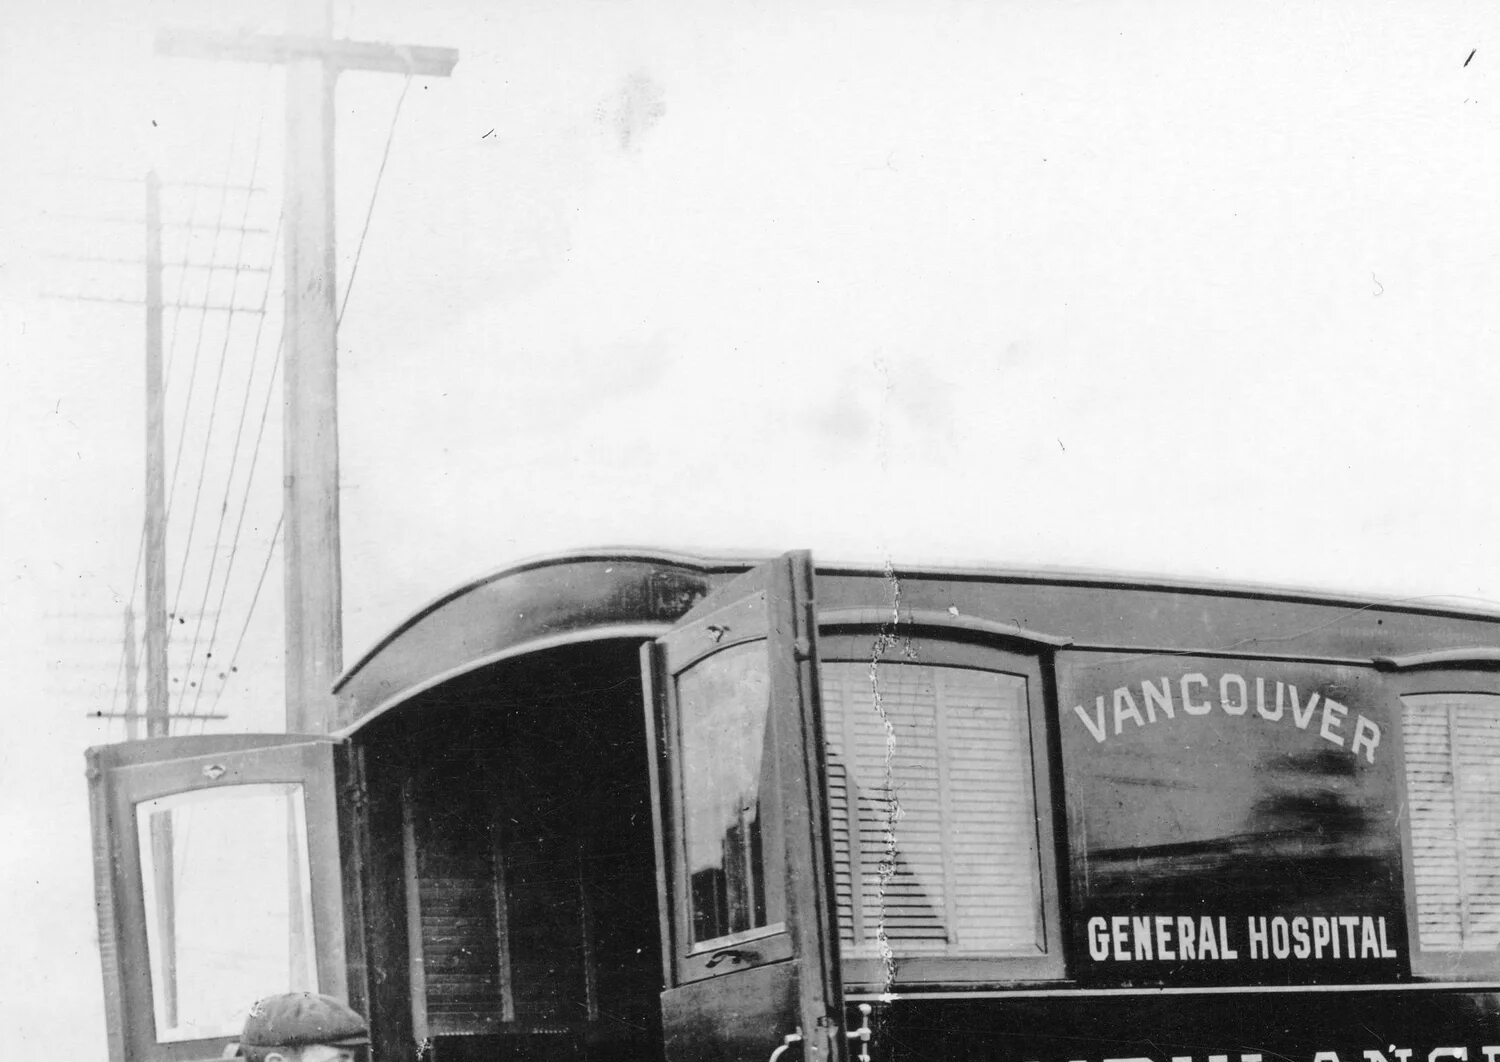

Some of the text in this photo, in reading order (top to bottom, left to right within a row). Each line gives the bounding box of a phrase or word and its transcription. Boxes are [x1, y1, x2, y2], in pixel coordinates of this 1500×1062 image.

[1074, 672, 1383, 763] VANCOUVER
[1087, 915, 1397, 961] GENERAL HOSPITAL
